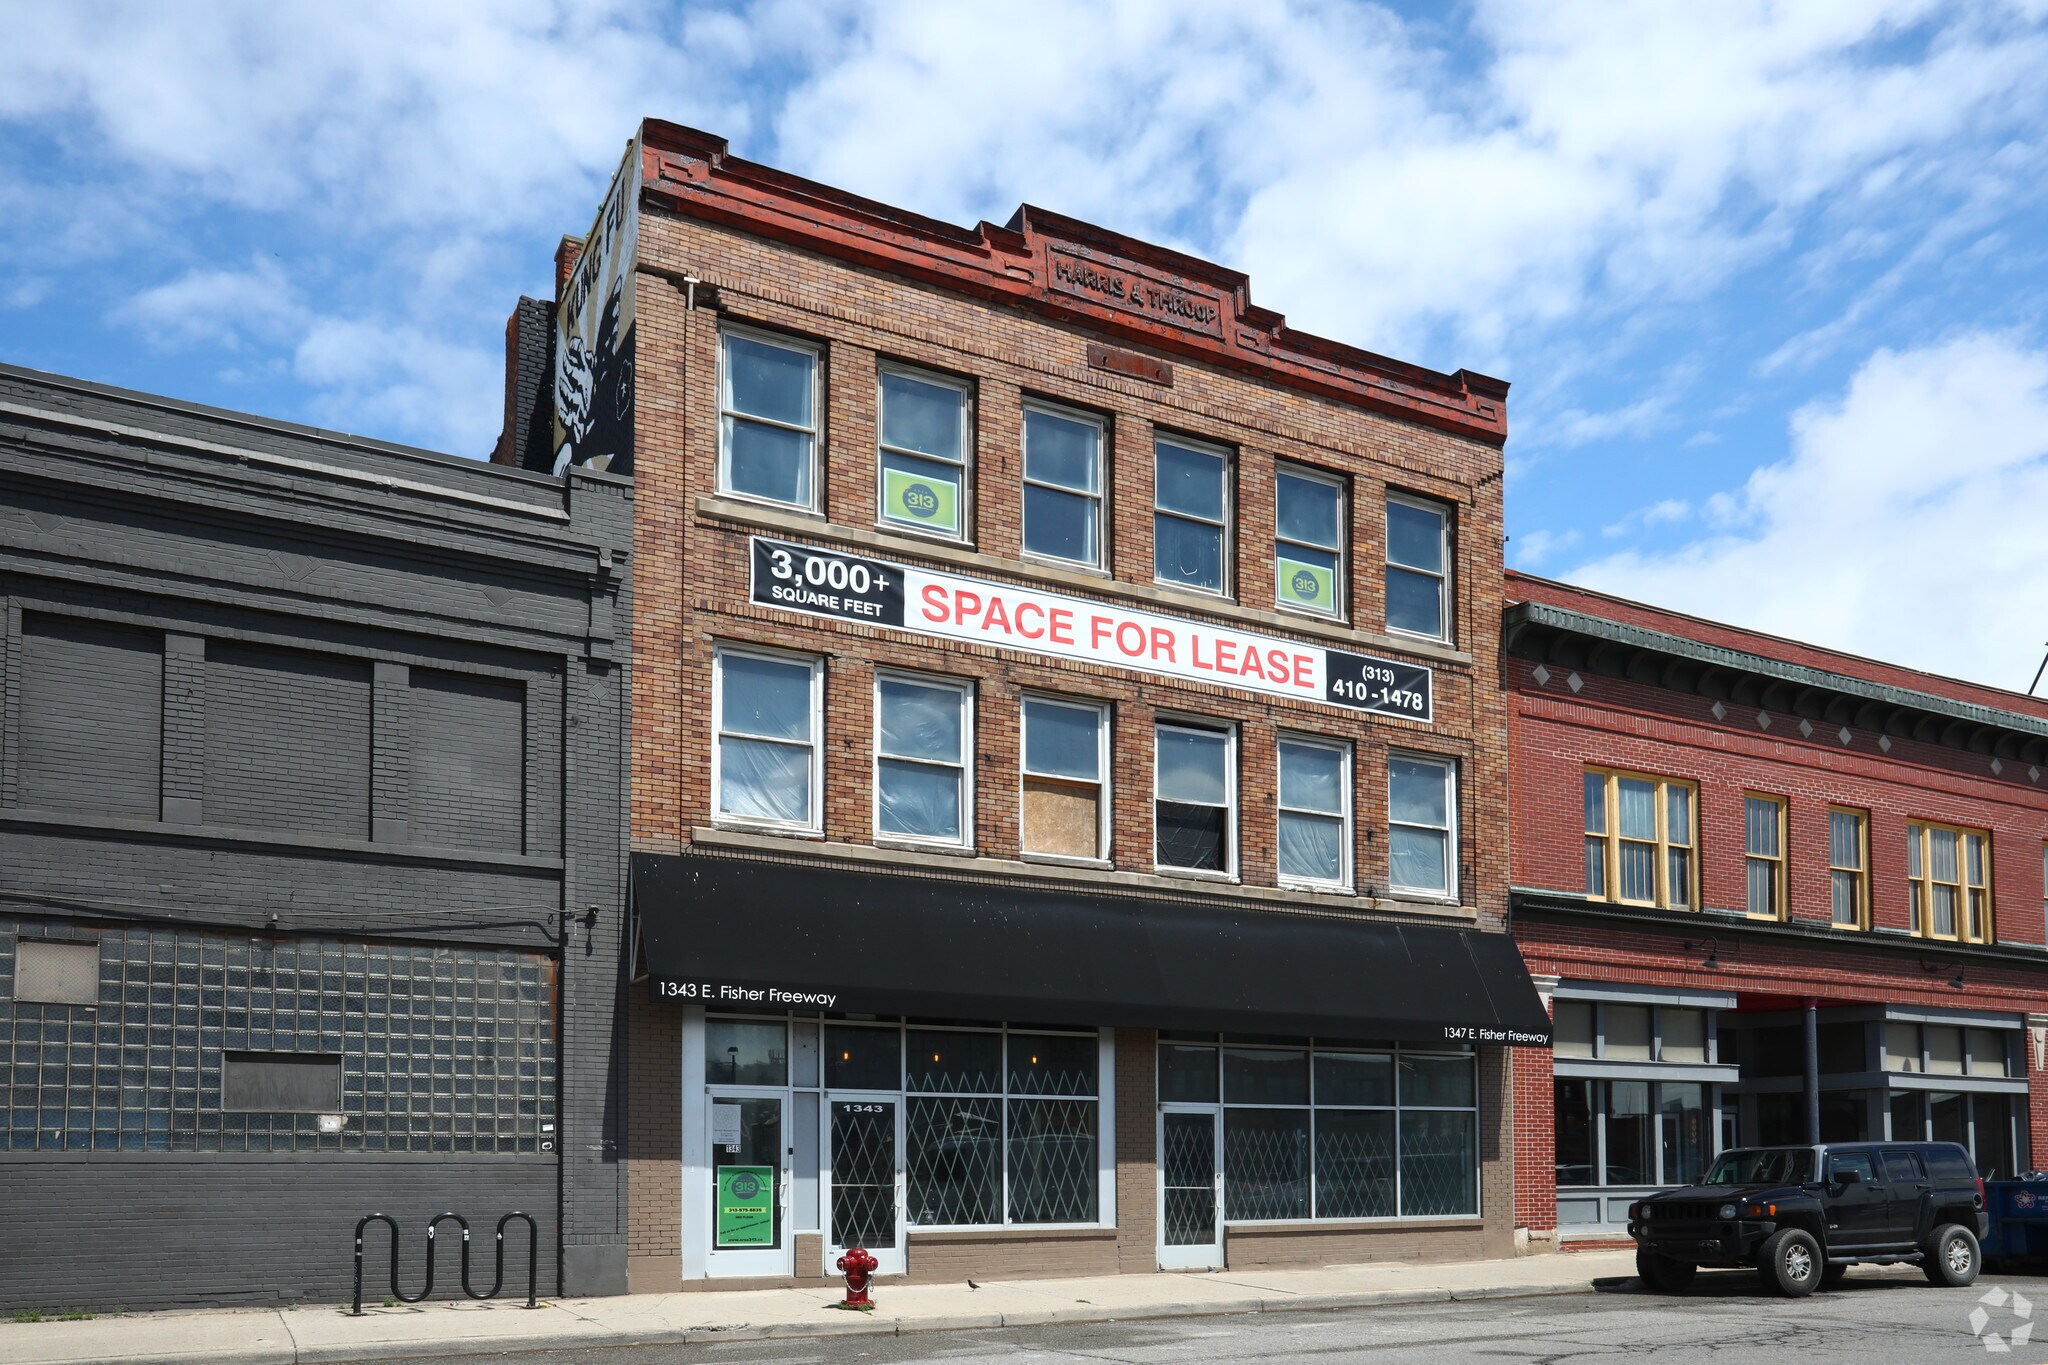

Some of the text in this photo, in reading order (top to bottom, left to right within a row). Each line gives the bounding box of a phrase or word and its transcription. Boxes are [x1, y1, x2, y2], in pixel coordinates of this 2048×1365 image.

[566, 177, 626, 340] KUNG FU
[1056, 261, 1126, 298] HARRIS
[1147, 287, 1219, 324] THROOP
[908, 492, 934, 508] 313
[771, 549, 890, 594] 3,000+
[1295, 577, 1316, 592] 313
[771, 585, 884, 617] SQUARE FEET
[921, 584, 1315, 689] SPACE FOR LEASE
[1361, 664, 1395, 686] (313)
[659, 981, 836, 1007] 1343 E. Fisher Freeway
[1444, 1027, 1548, 1044] 1347 E. Fisher Freeway
[843, 1104, 883, 1113] 1343
[735, 1182, 755, 1191] 313
